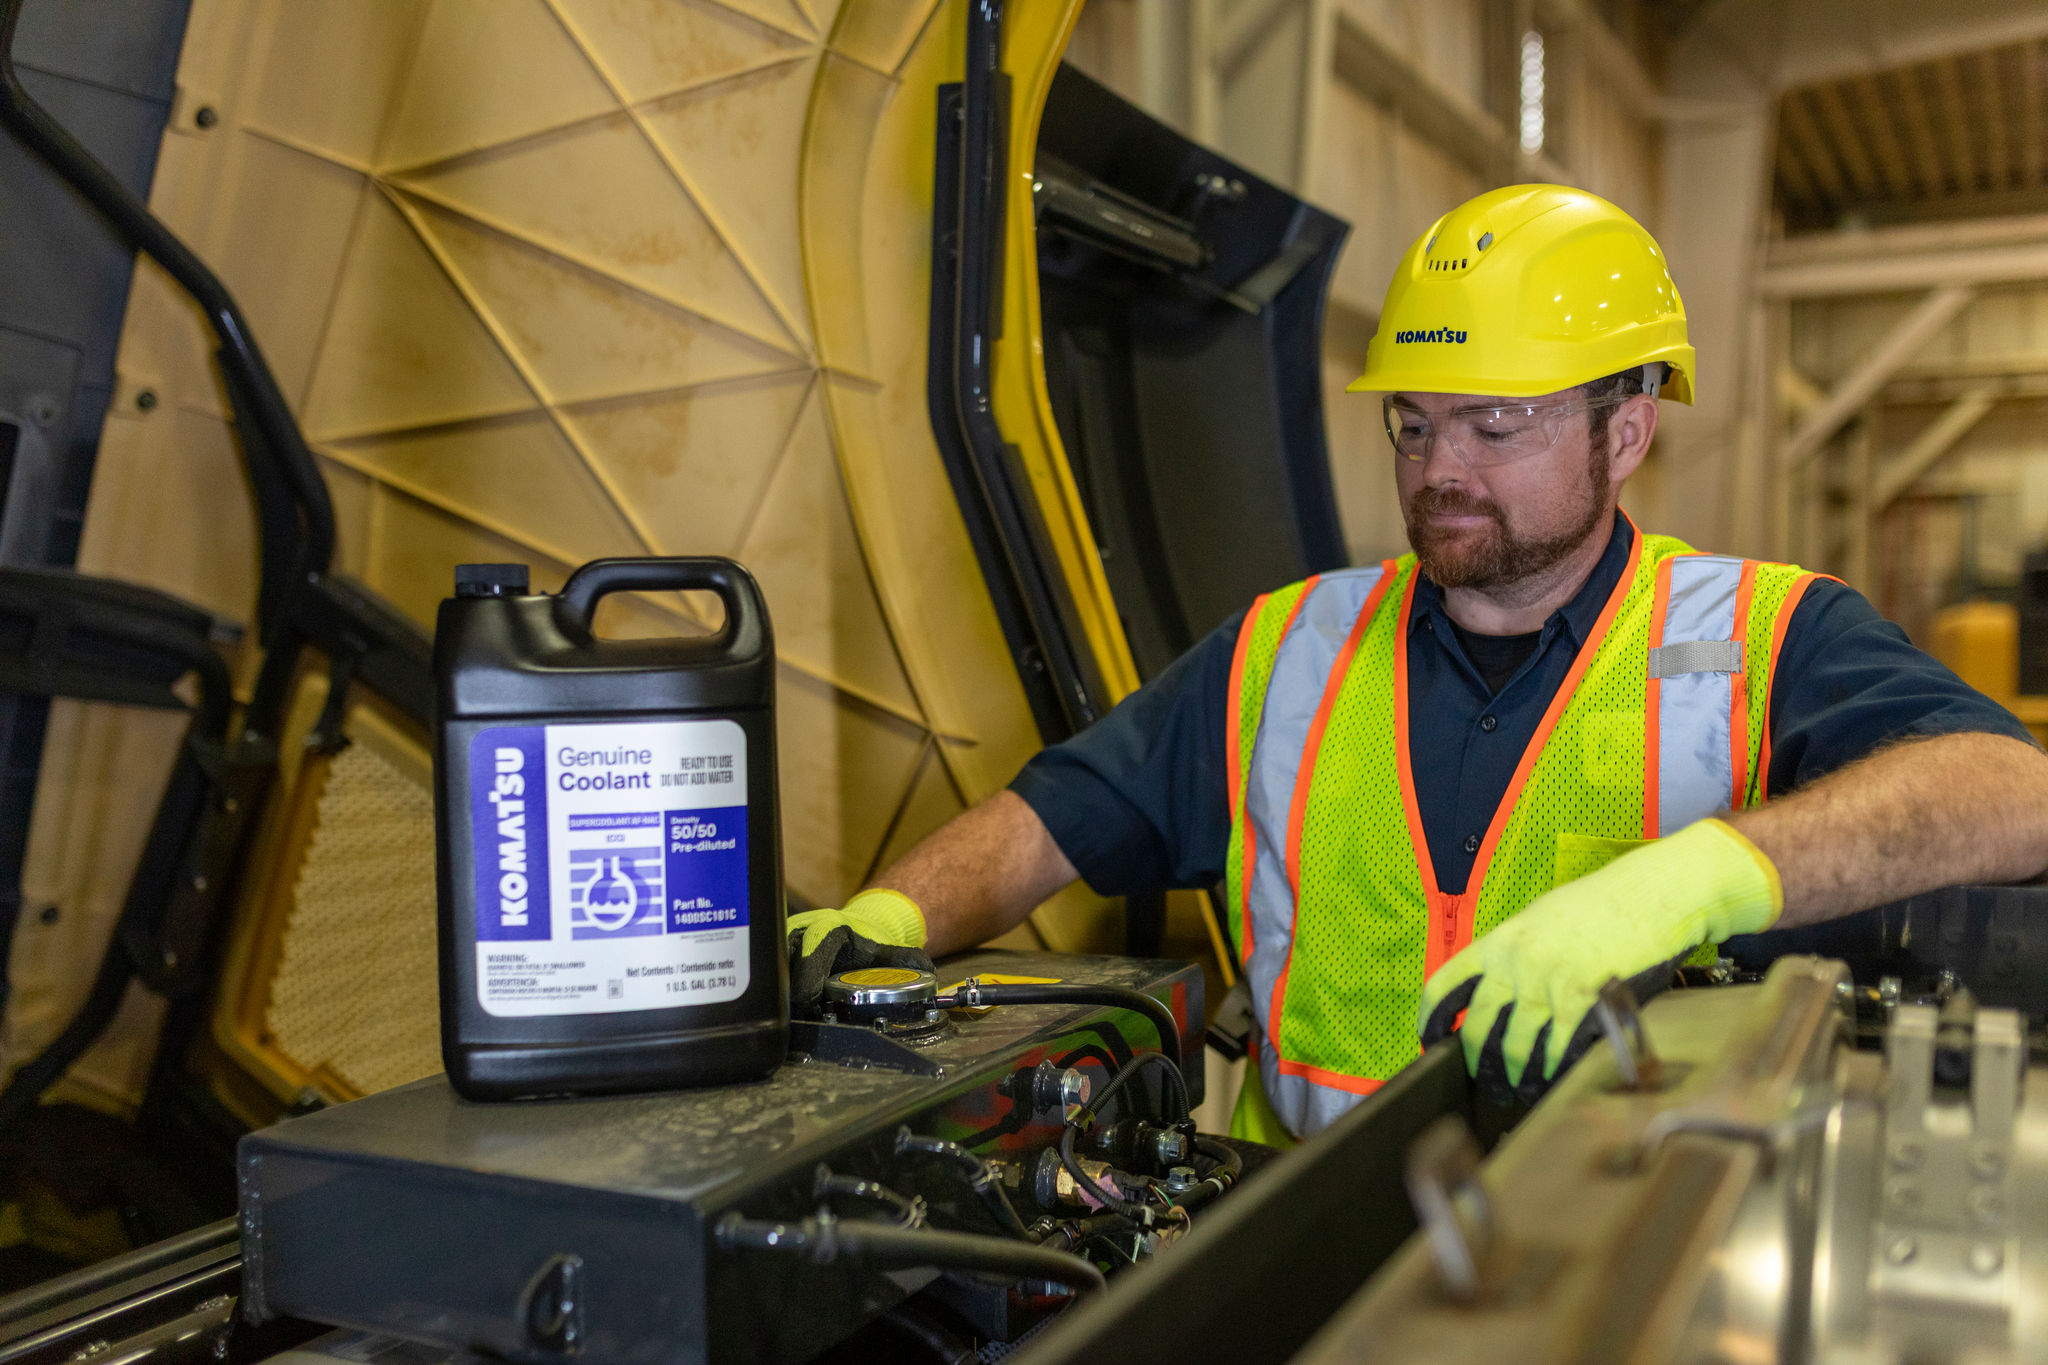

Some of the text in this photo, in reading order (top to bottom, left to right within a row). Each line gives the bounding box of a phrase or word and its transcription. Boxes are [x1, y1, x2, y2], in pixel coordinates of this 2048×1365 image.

[1395, 327, 1467, 344] KOMATSU
[557, 746, 652, 767] Genuine
[681, 755, 734, 770] READY TO USE
[559, 771, 652, 791] Coolant
[660, 770, 734, 787] DO NOT ADD WATER
[670, 816, 700, 825] Density
[488, 747, 528, 926] KOMATSU
[671, 823, 717, 840] 50/50
[671, 838, 736, 853] Pre-diluted
[673, 897, 713, 911] Part No.
[626, 967, 640, 978] Net
[641, 965, 674, 977] Contents
[666, 982, 671, 993] 1
[673, 980, 688, 992] U.S.
[691, 979, 705, 991] GAL
